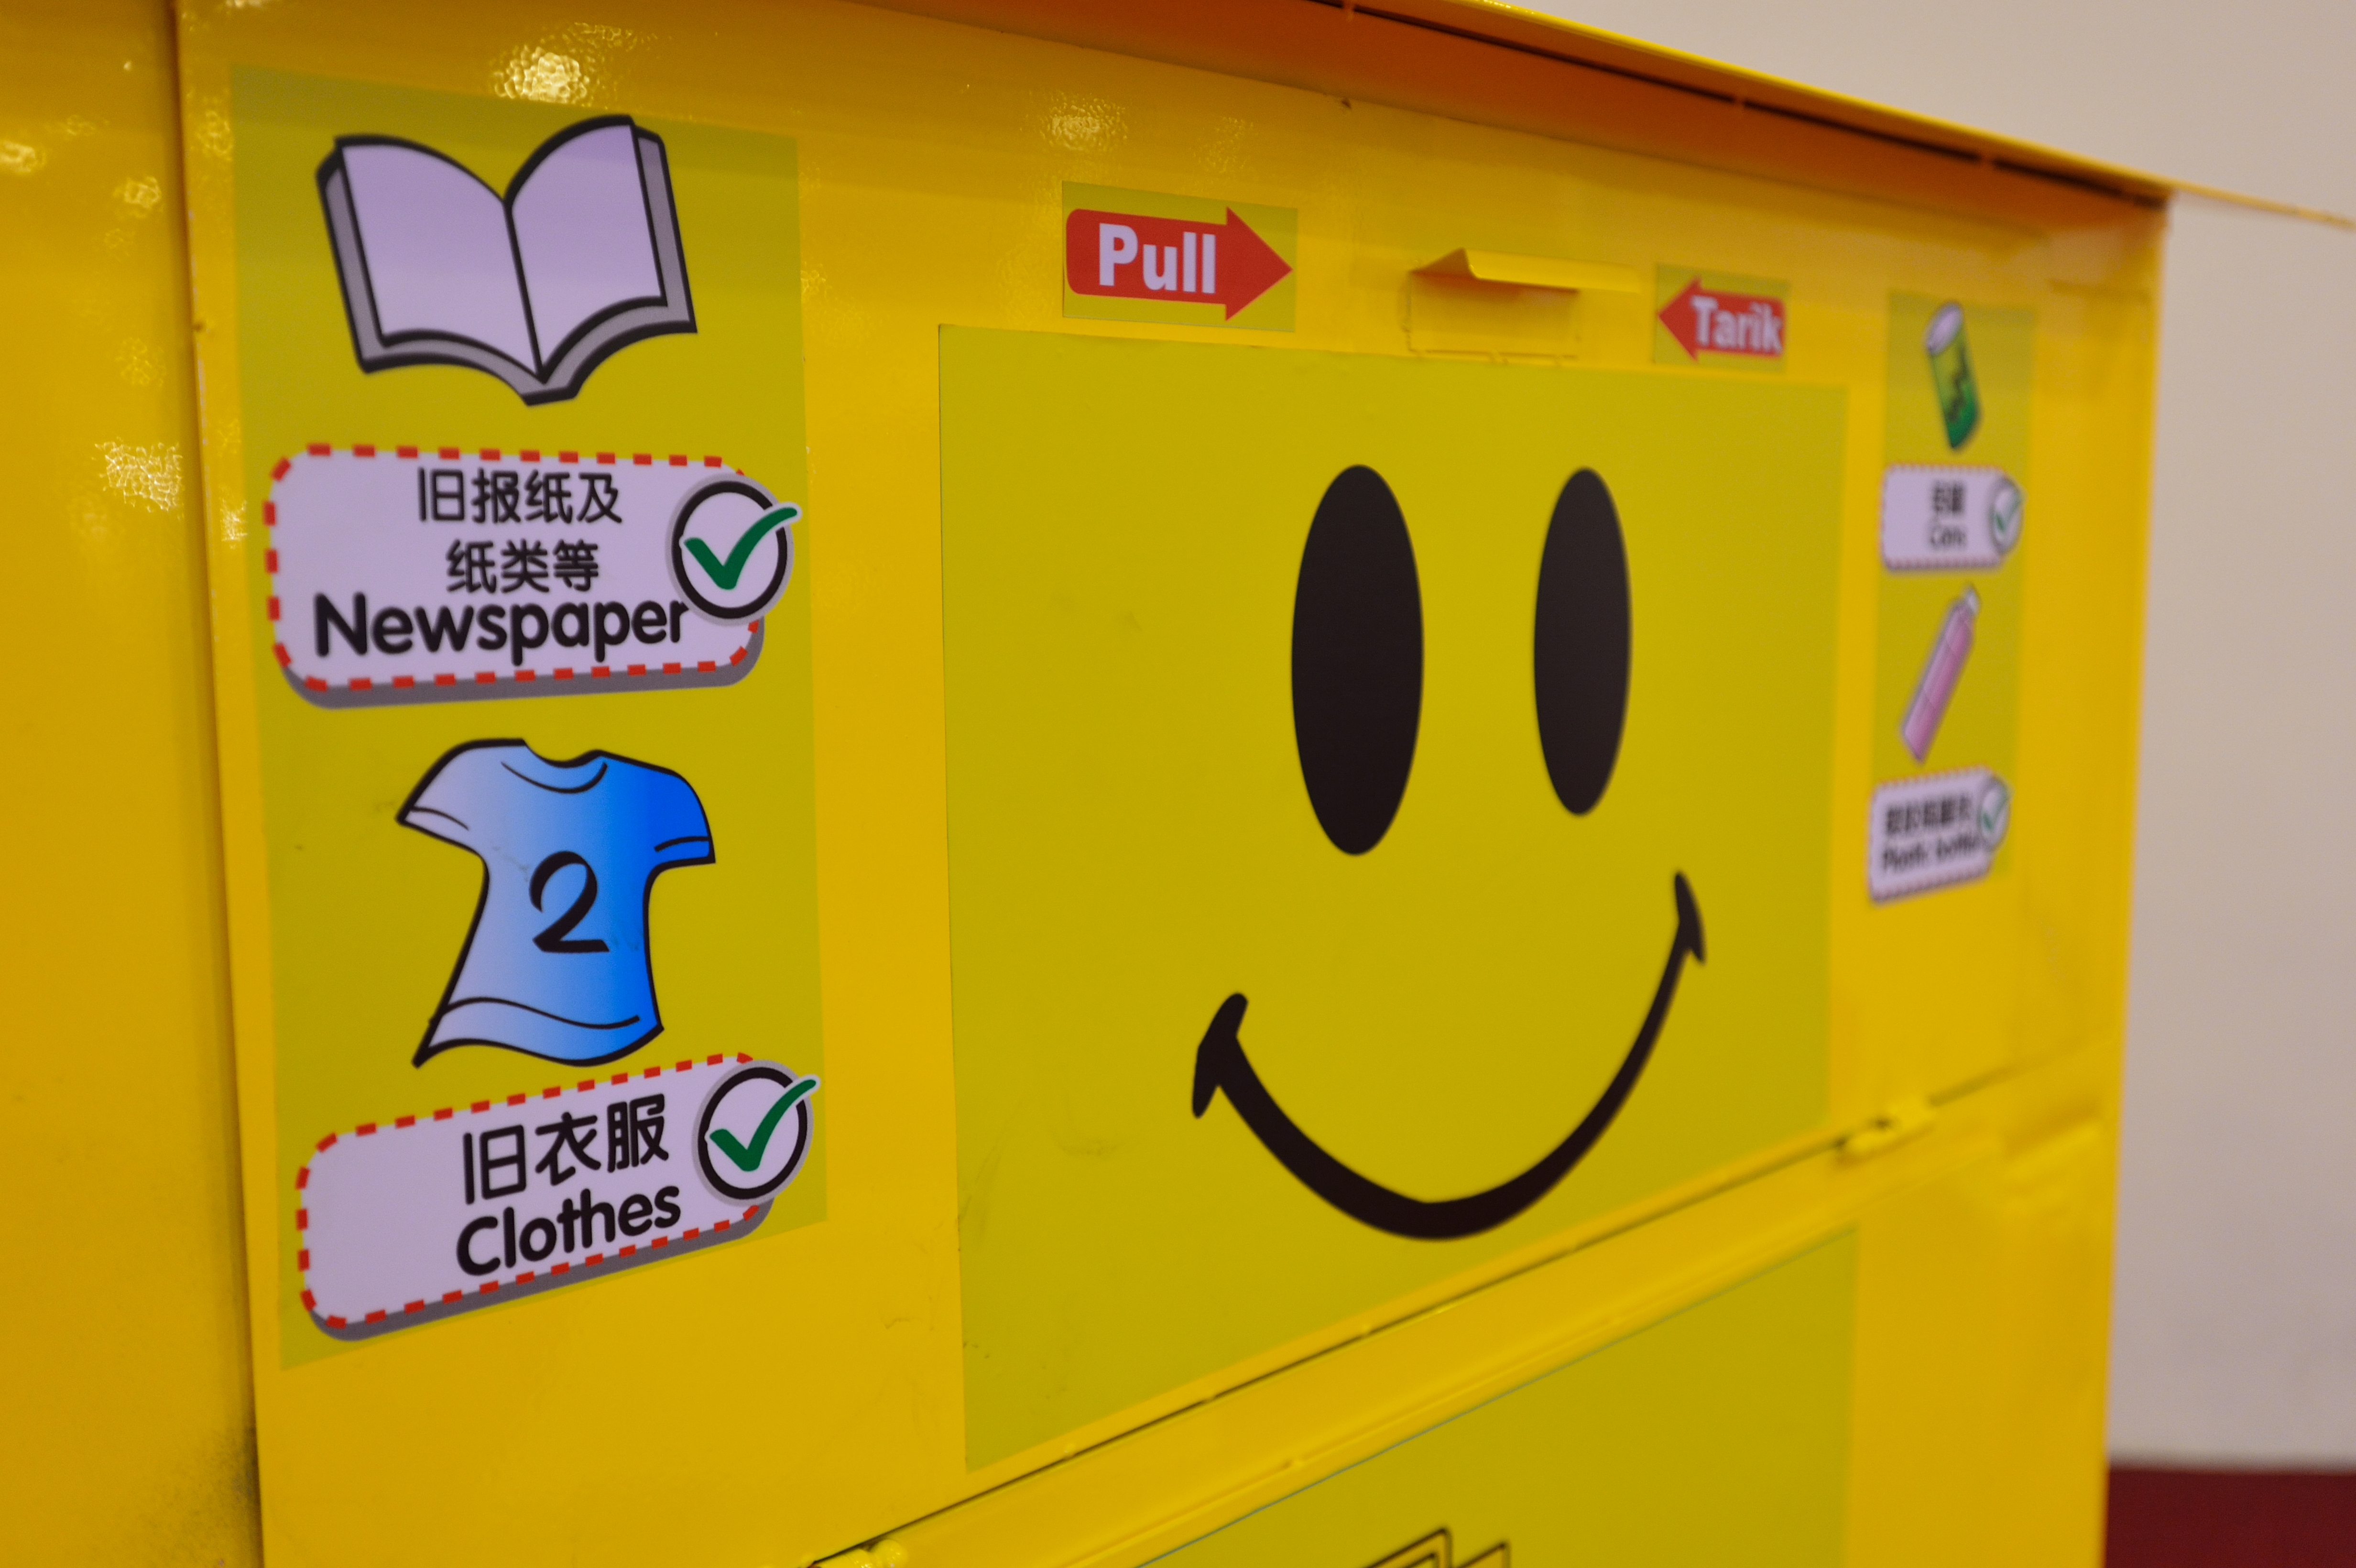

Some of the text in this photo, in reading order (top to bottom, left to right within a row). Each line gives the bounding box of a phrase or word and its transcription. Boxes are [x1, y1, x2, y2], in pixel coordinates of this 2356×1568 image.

[1100, 223, 1216, 294] Pull
[1690, 294, 1783, 355] Tarik
[418, 467, 622, 524] 旧报纸及
[447, 539, 599, 594] 纸类等
[314, 592, 689, 666] Newspaper
[530, 851, 610, 954] 2
[463, 1093, 669, 1205] 旧衣服
[456, 1186, 681, 1276] Clothes
